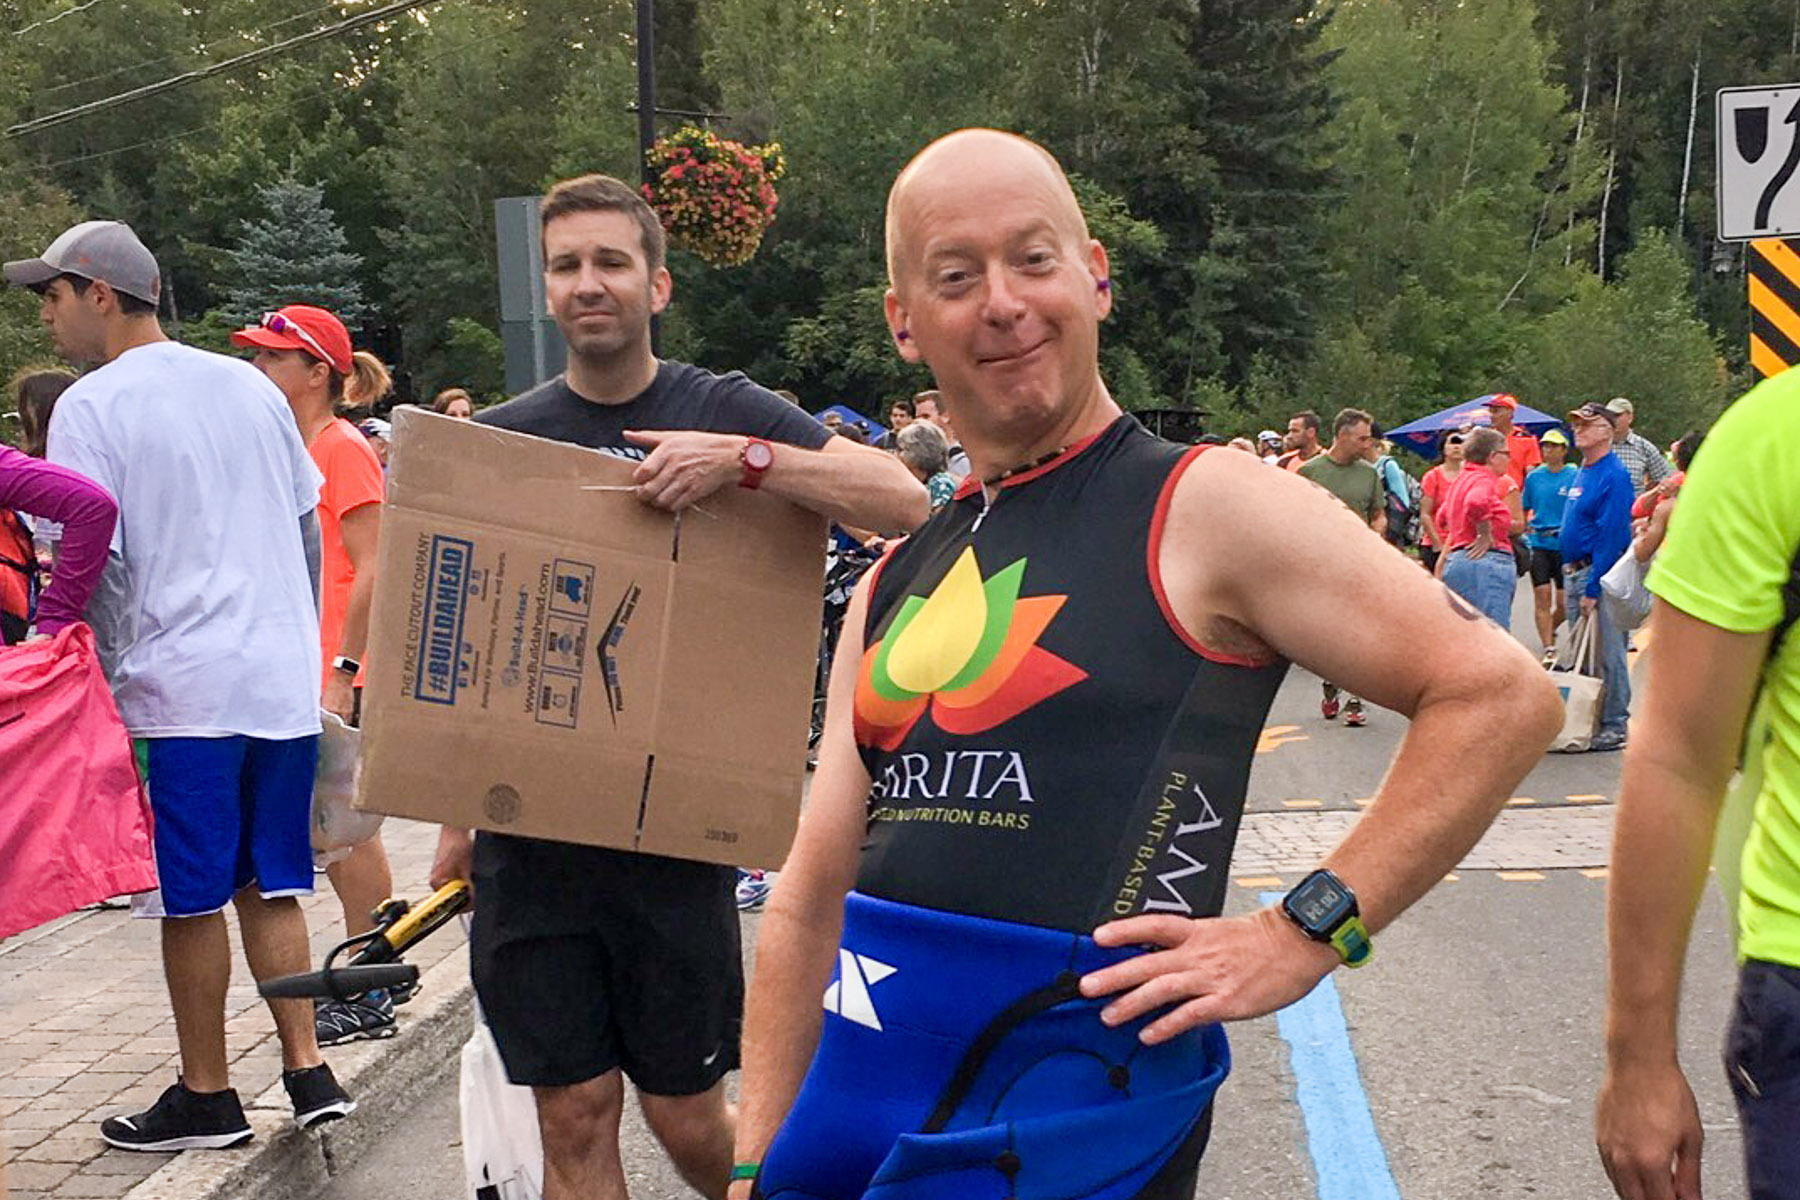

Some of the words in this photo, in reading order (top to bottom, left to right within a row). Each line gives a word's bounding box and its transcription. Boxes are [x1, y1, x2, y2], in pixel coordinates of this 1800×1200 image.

[413, 532, 432, 590] COMPANY
[407, 593, 424, 642] CUTOUT
[428, 546, 464, 693] #BUILDAHEAD
[523, 563, 550, 714] www.Buildahead.com
[404, 645, 418, 671] FACE
[401, 672, 415, 698] THE
[895, 807, 974, 825] NUTRITION
[977, 810, 1031, 831] BARS
[1112, 771, 1188, 916] PLANT-BASED
